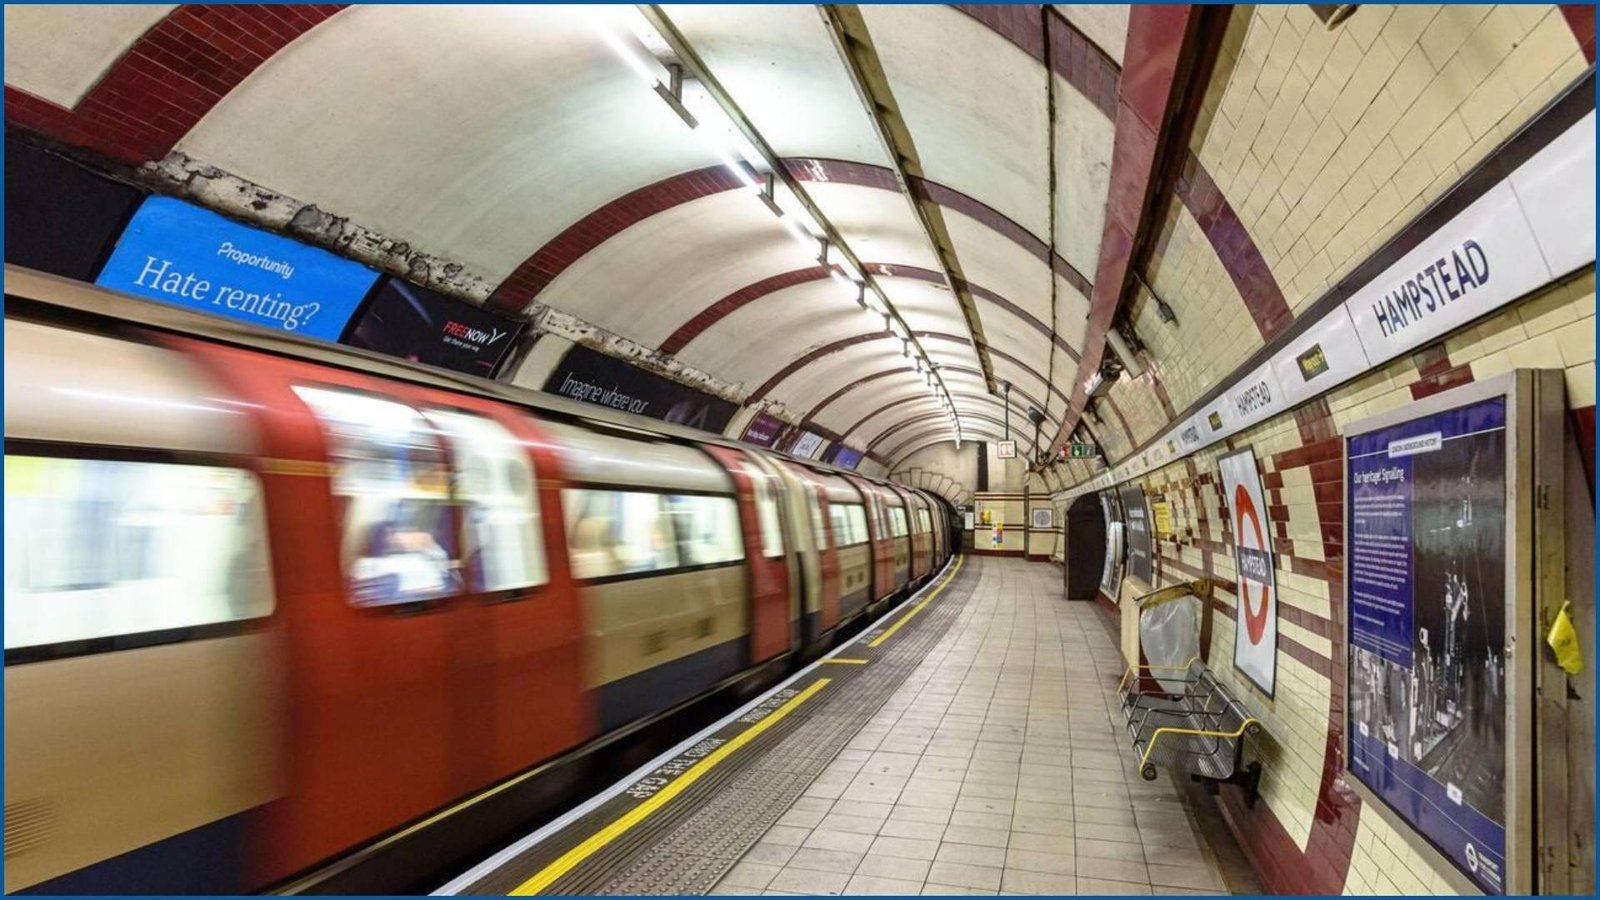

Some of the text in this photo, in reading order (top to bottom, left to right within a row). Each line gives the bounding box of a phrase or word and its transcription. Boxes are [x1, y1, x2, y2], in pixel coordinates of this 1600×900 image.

[217, 242, 295, 279] Proportunity
[1372, 239, 1489, 338] HAMPSTEAD
[133, 256, 320, 331] Hate renting?
[560, 371, 602, 403] Imagine
[600, 386, 630, 410] where
